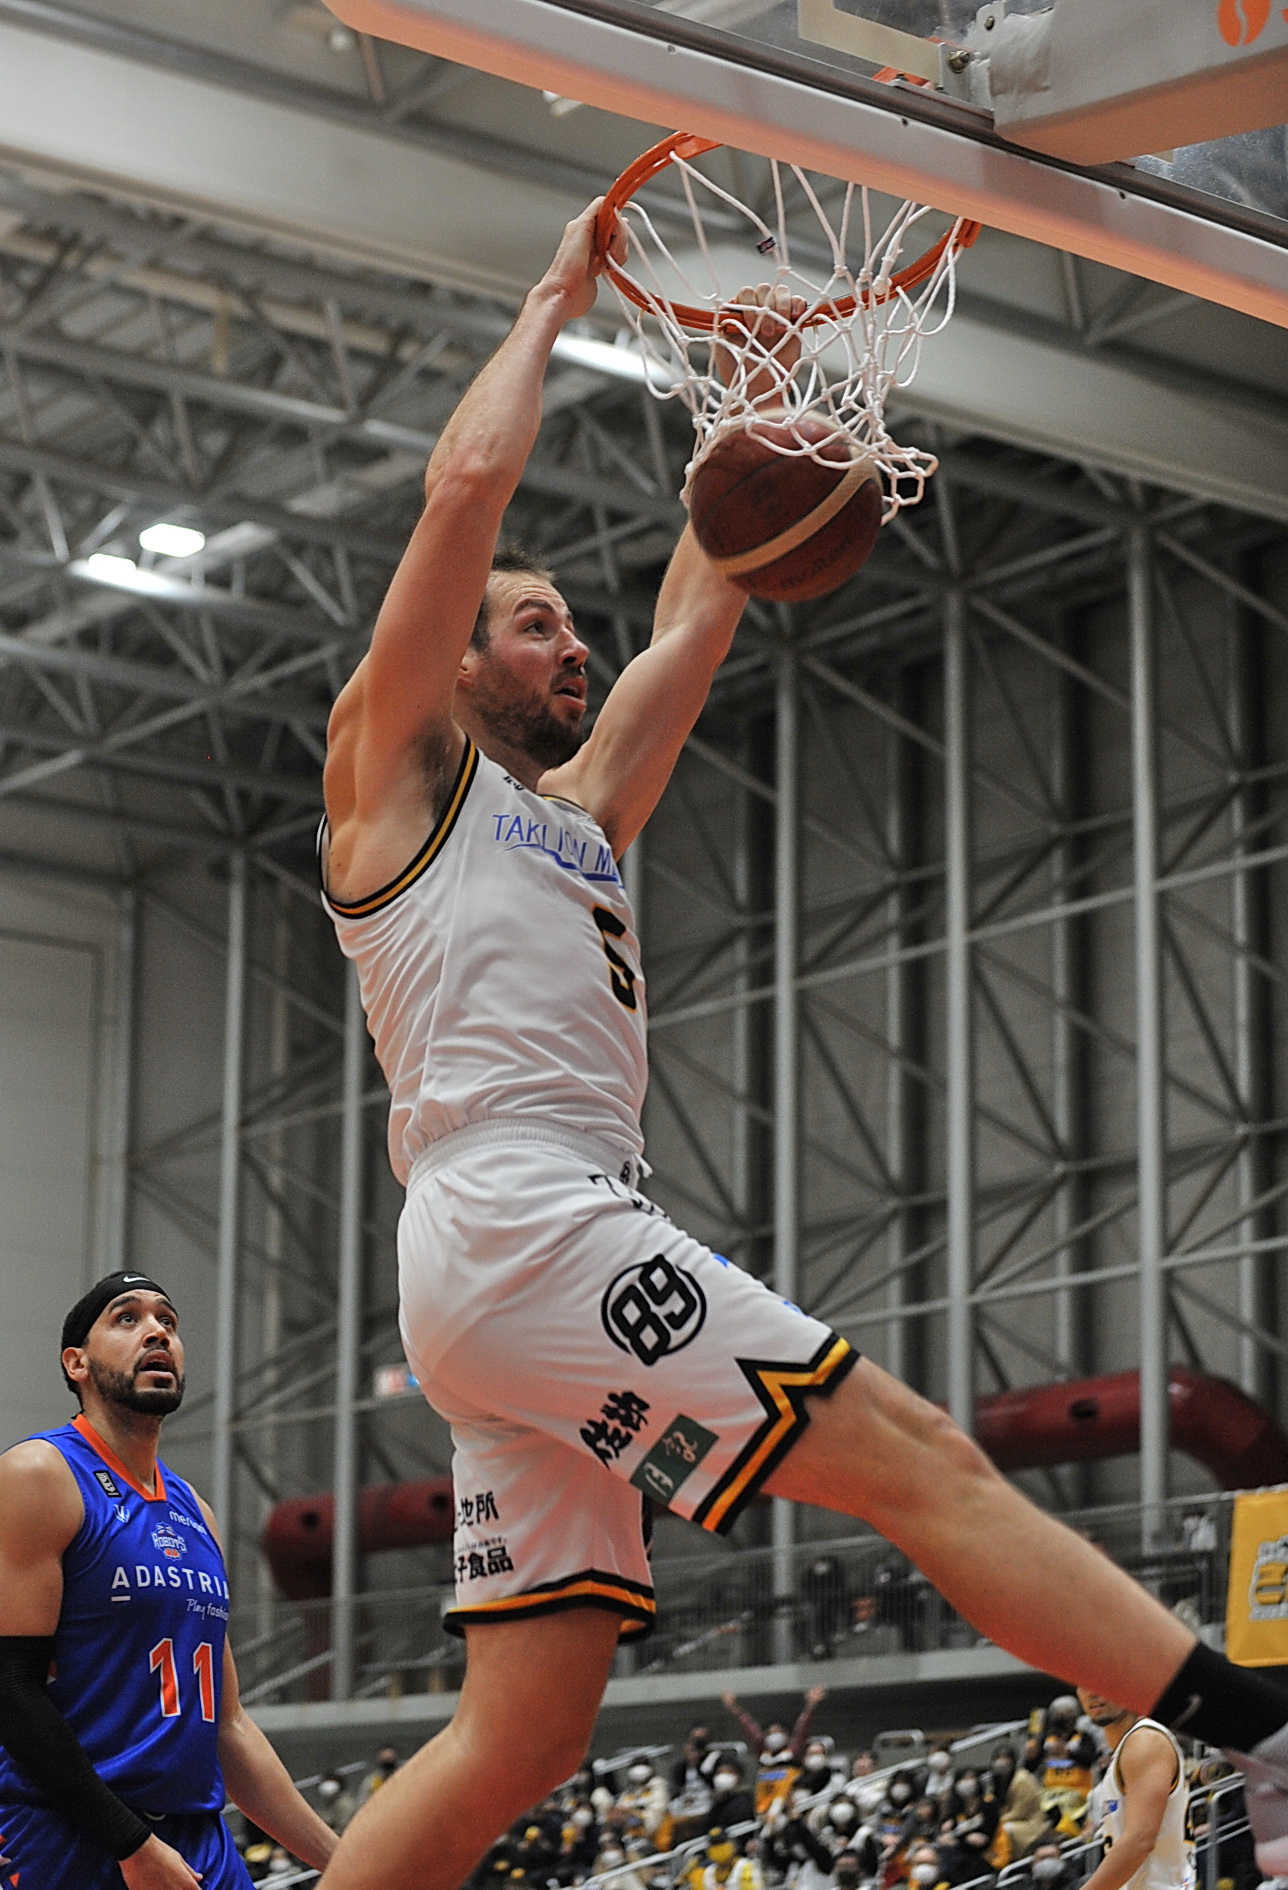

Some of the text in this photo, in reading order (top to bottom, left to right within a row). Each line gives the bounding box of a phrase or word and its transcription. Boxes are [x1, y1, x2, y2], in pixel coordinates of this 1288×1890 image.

[610, 1254, 697, 1366] 89
[454, 1490, 500, 1532] 地所
[151, 1531, 187, 1552] ROBOTS
[455, 1546, 514, 1583] 子食品
[149, 1636, 215, 1724] 11
